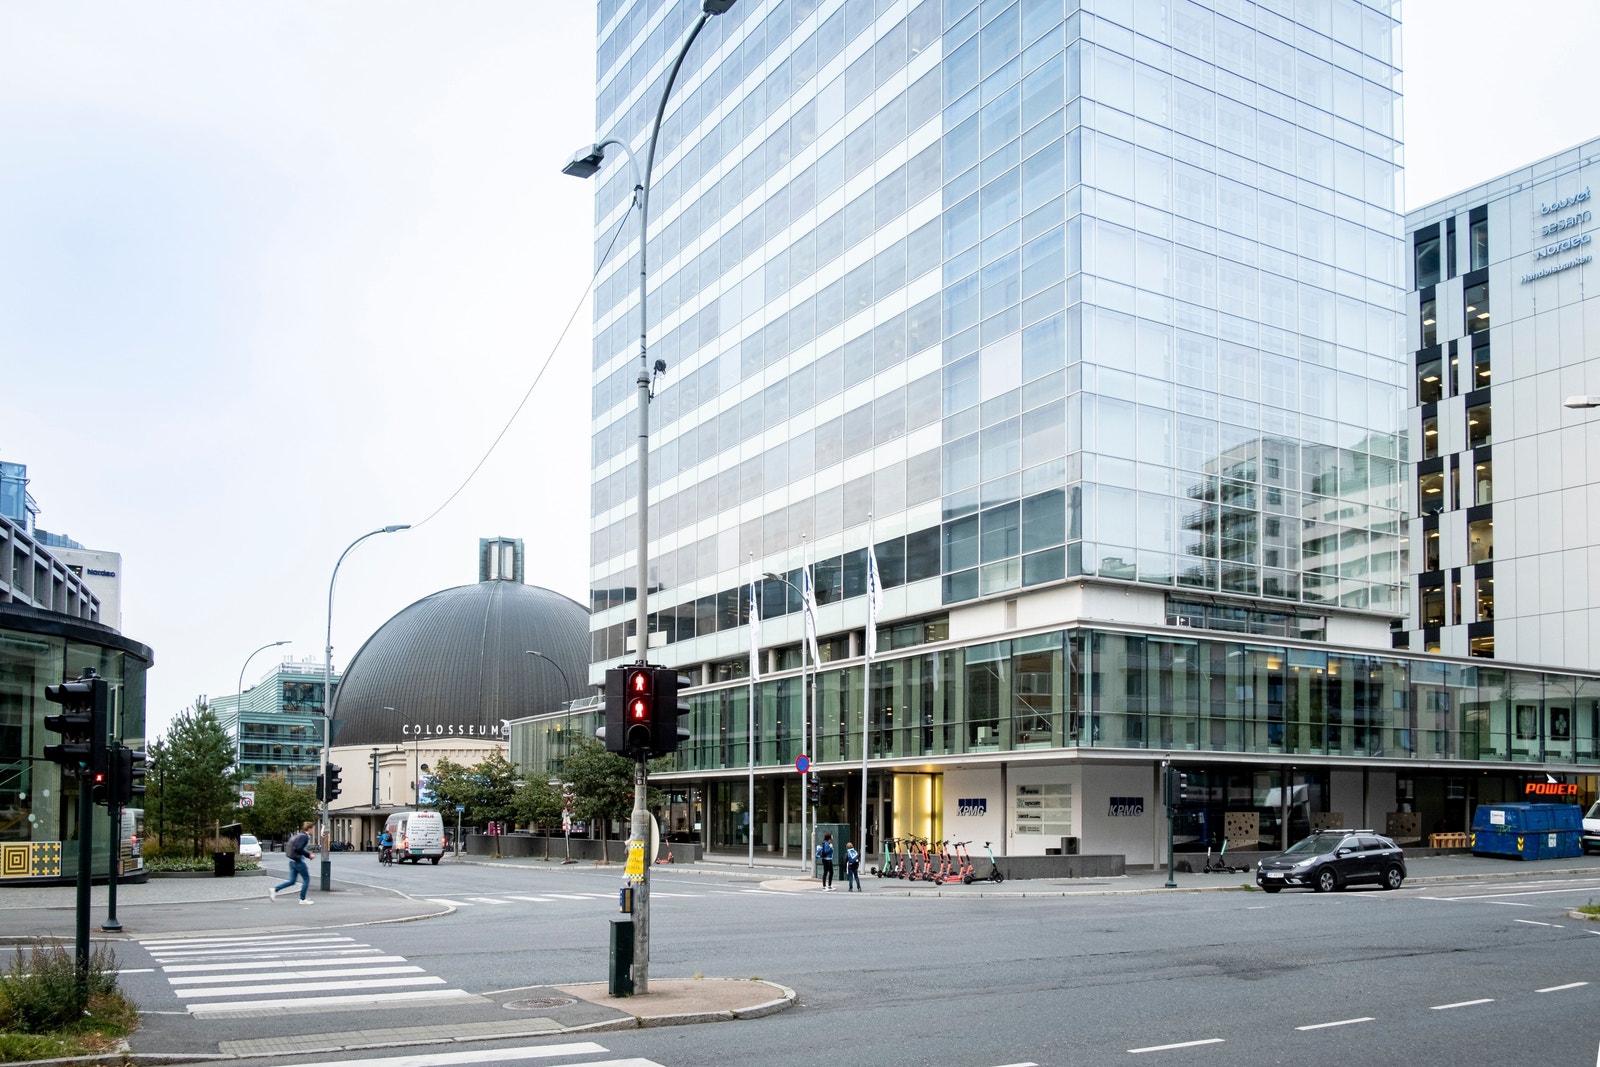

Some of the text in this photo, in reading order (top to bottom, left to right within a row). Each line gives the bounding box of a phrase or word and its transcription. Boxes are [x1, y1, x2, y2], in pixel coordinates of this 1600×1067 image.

[1541, 186, 1591, 215] bouvet
[1542, 211, 1592, 236] sesam
[1537, 234, 1592, 260] Nordea
[1521, 256, 1592, 284] Handelsbanken
[402, 724, 498, 735] COLOSSEUM
[1525, 783, 1578, 794] POWER
[957, 806, 985, 816] KPMG
[1108, 805, 1142, 816] KPMG
